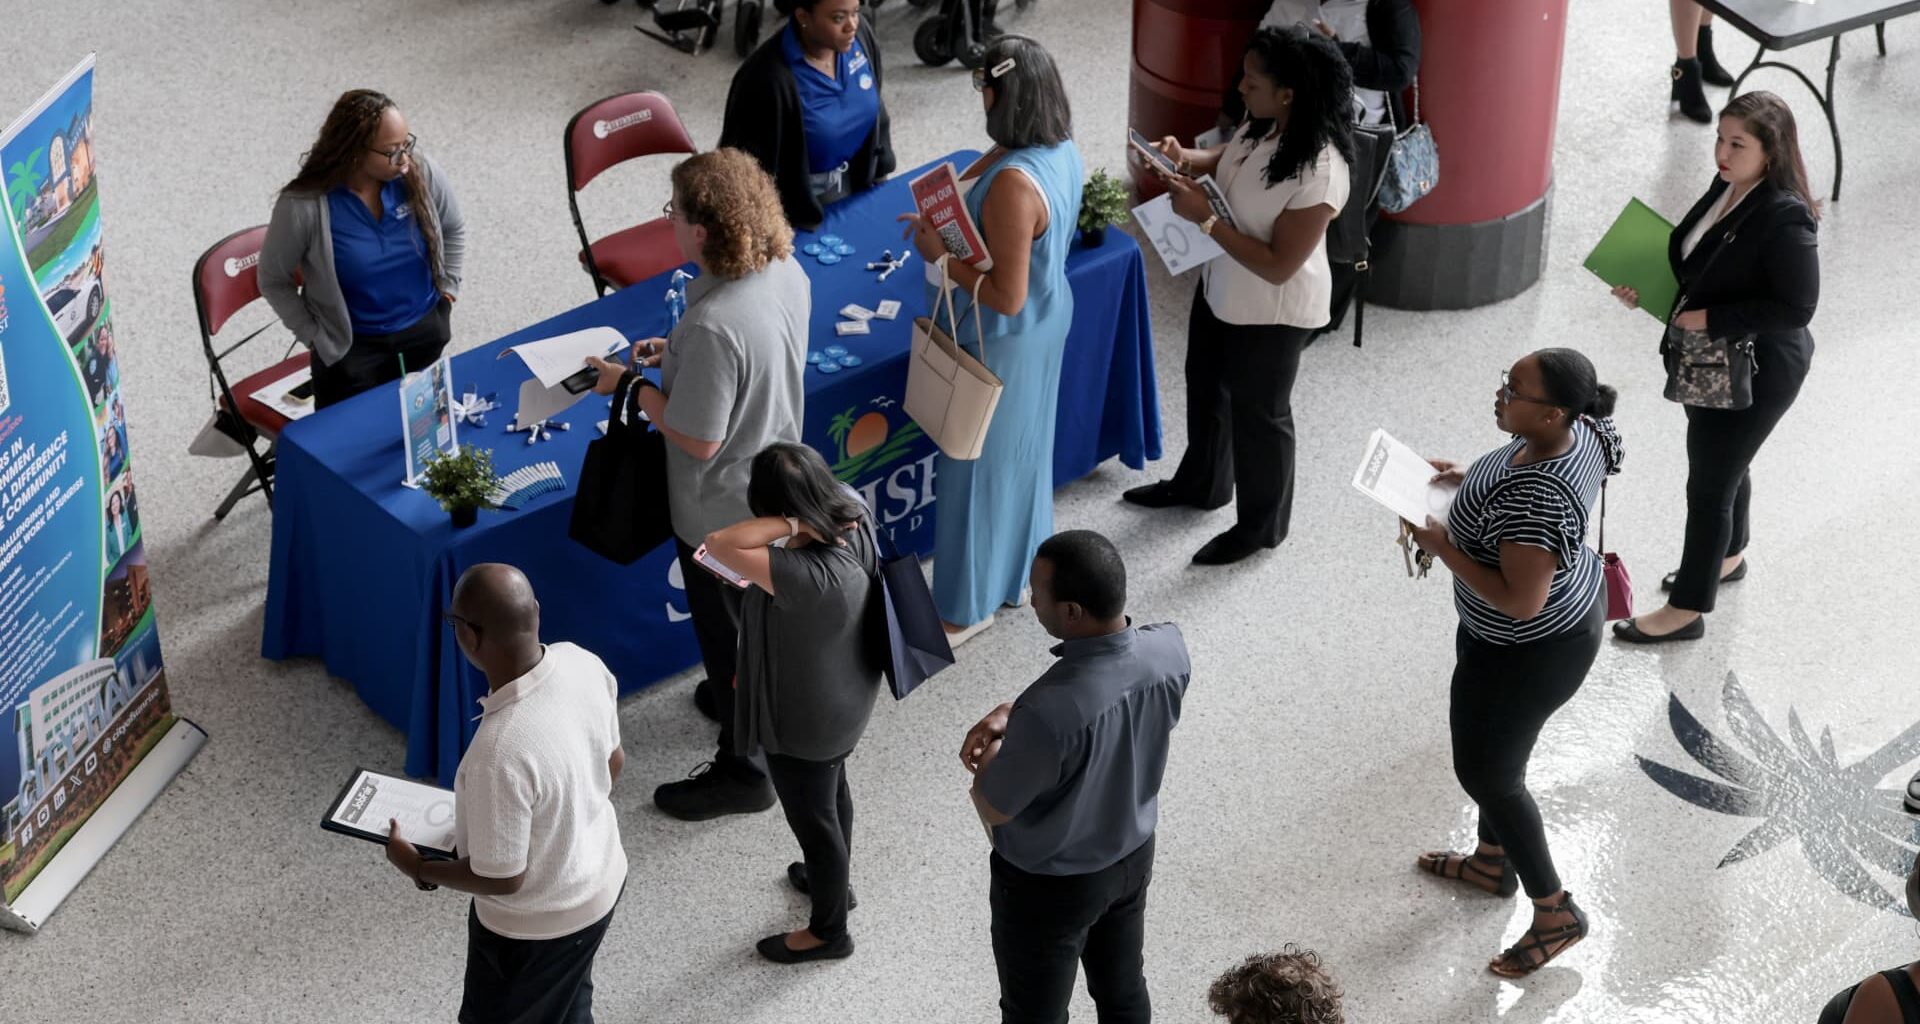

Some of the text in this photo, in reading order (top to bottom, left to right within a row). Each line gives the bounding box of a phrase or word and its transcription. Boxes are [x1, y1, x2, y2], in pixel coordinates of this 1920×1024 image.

[920, 184, 953, 209] JOIN OUR
[931, 205, 953, 226] TEAM!
[2, 492, 10, 509] A
[11, 429, 69, 498] DIFFERENCE
[11, 436, 23, 459] IN
[6, 448, 67, 521] COMMUNITY
[45, 486, 60, 509] AND
[23, 515, 46, 544] WORK
[46, 505, 56, 521] IN
[55, 476, 84, 511] SUNRISE
[82, 650, 158, 744] HALL
